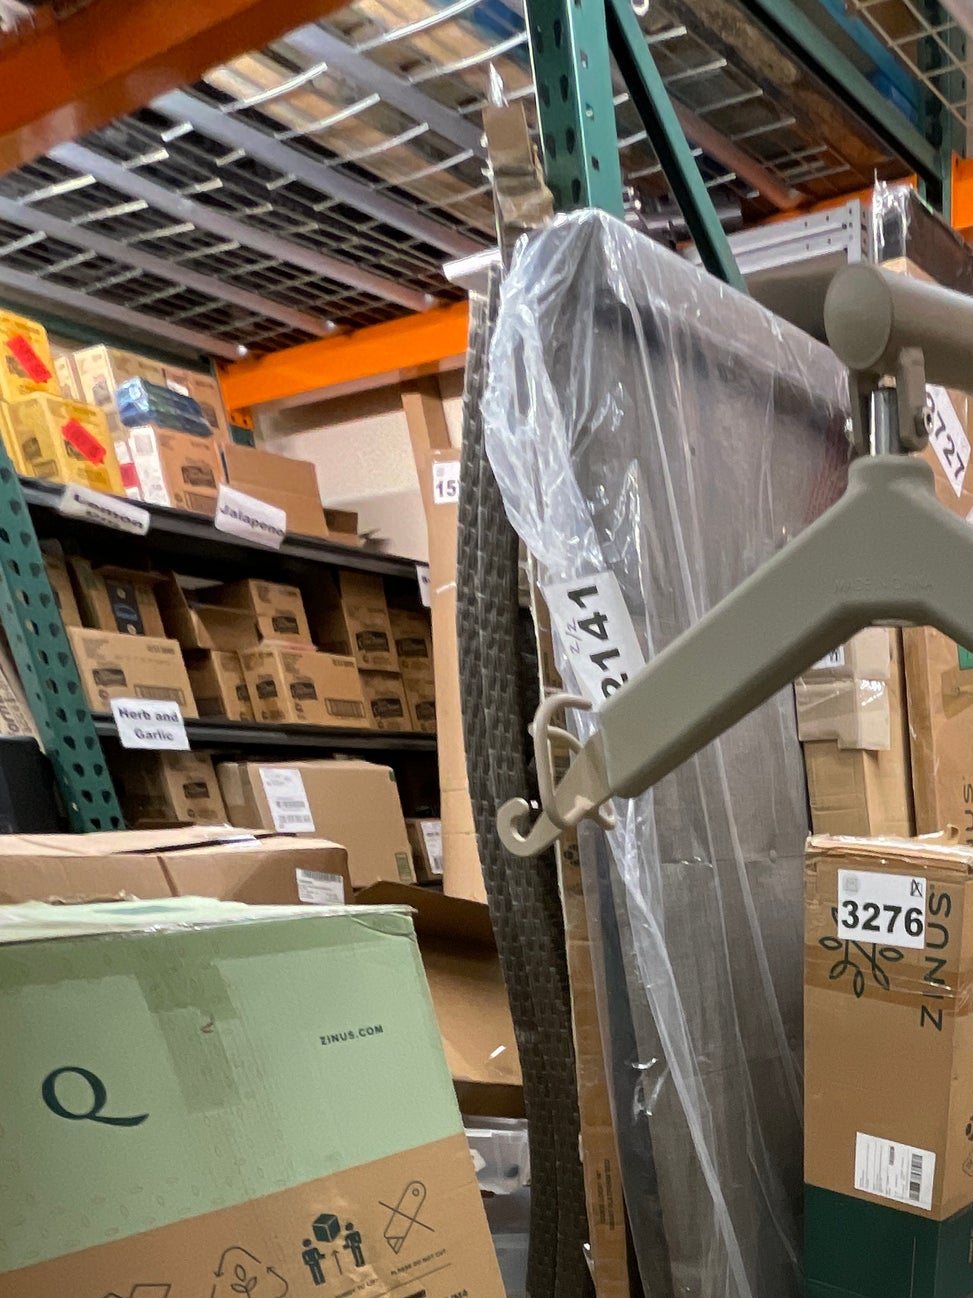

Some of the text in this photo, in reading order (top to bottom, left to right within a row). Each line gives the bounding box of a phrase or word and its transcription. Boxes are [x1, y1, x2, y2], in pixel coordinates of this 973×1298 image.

[925, 391, 966, 480] 727
[118, 707, 180, 723] Herb and
[134, 728, 176, 742] Garlic
[841, 900, 924, 937] 3276
[920, 892, 952, 1031] ZINUS
[320, 1024, 384, 1046] ZINUS.COM
[42, 1066, 150, 1128] Q
